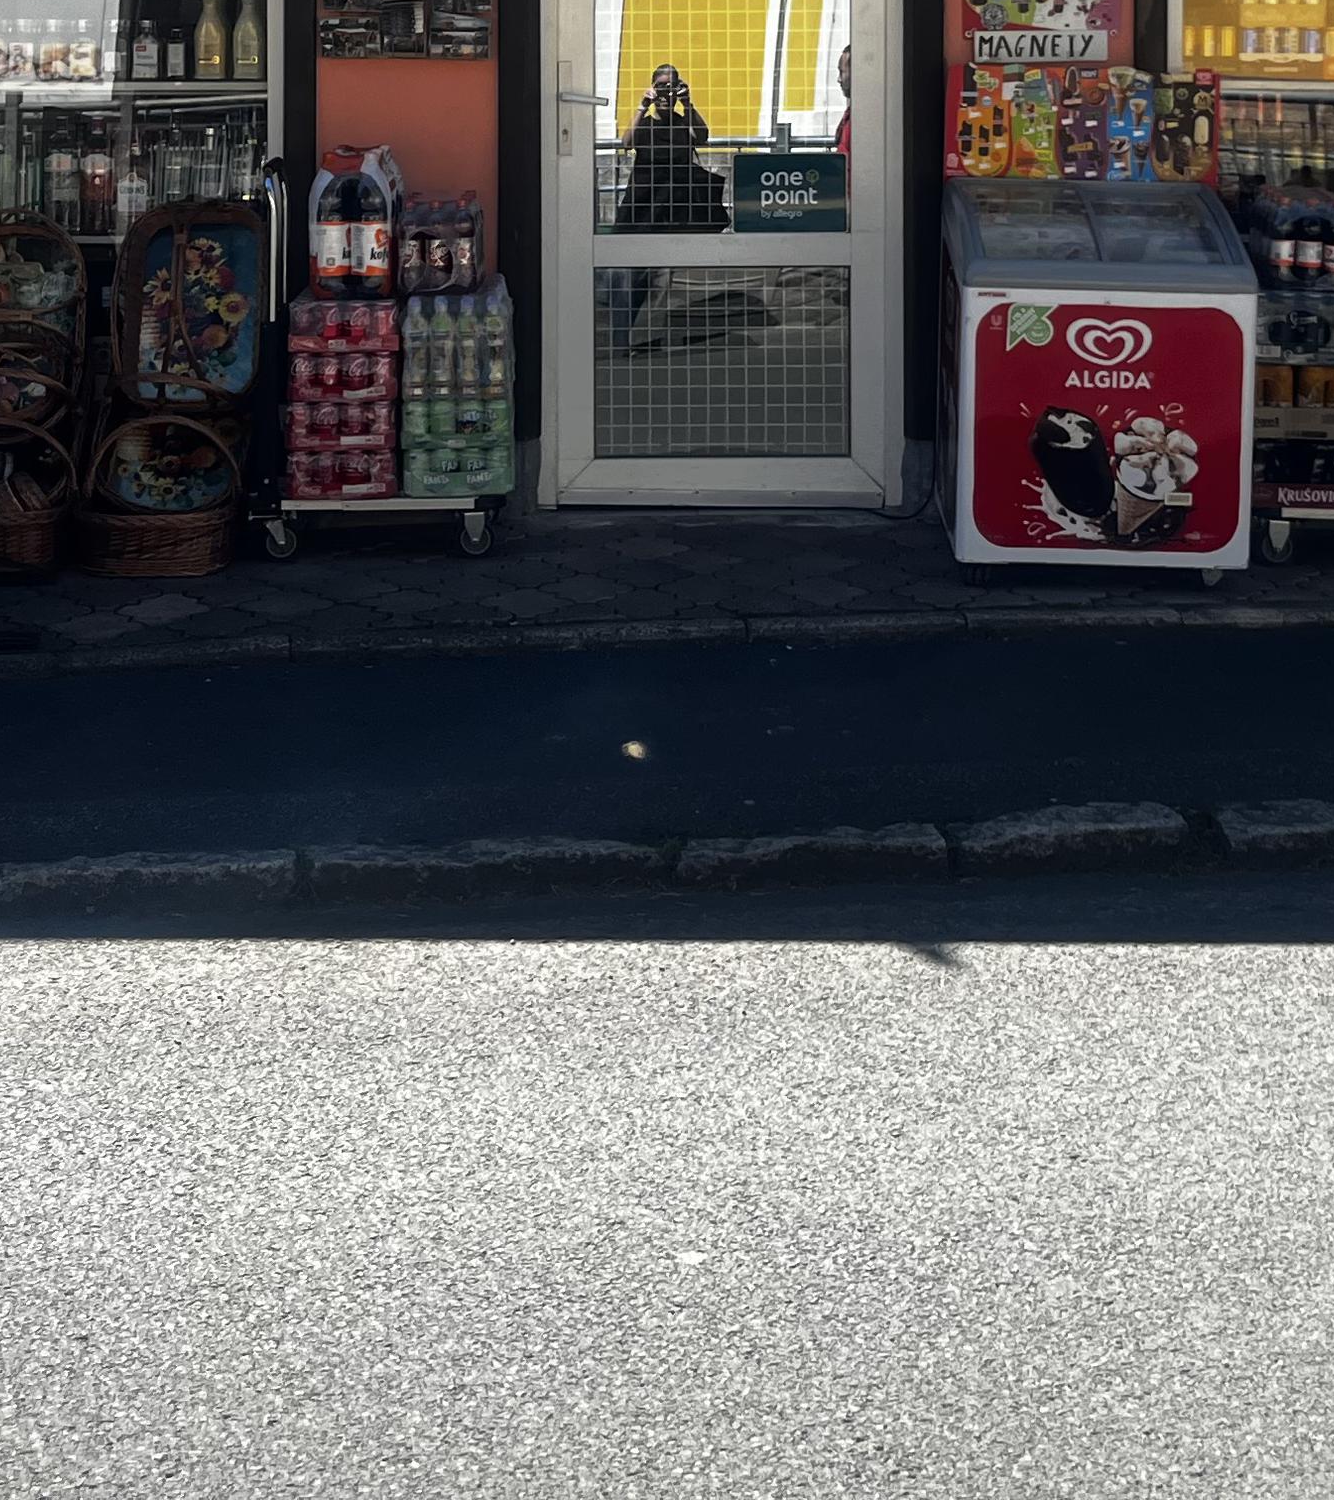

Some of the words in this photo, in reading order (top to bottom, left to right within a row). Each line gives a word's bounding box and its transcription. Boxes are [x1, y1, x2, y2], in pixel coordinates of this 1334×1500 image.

[978, 34, 1094, 58] MAGNETY
[760, 171, 803, 186] one
[760, 187, 818, 208] point
[760, 209, 771, 219] by
[772, 208, 803, 220] allegro
[1064, 370, 1152, 389] ALGIDA
